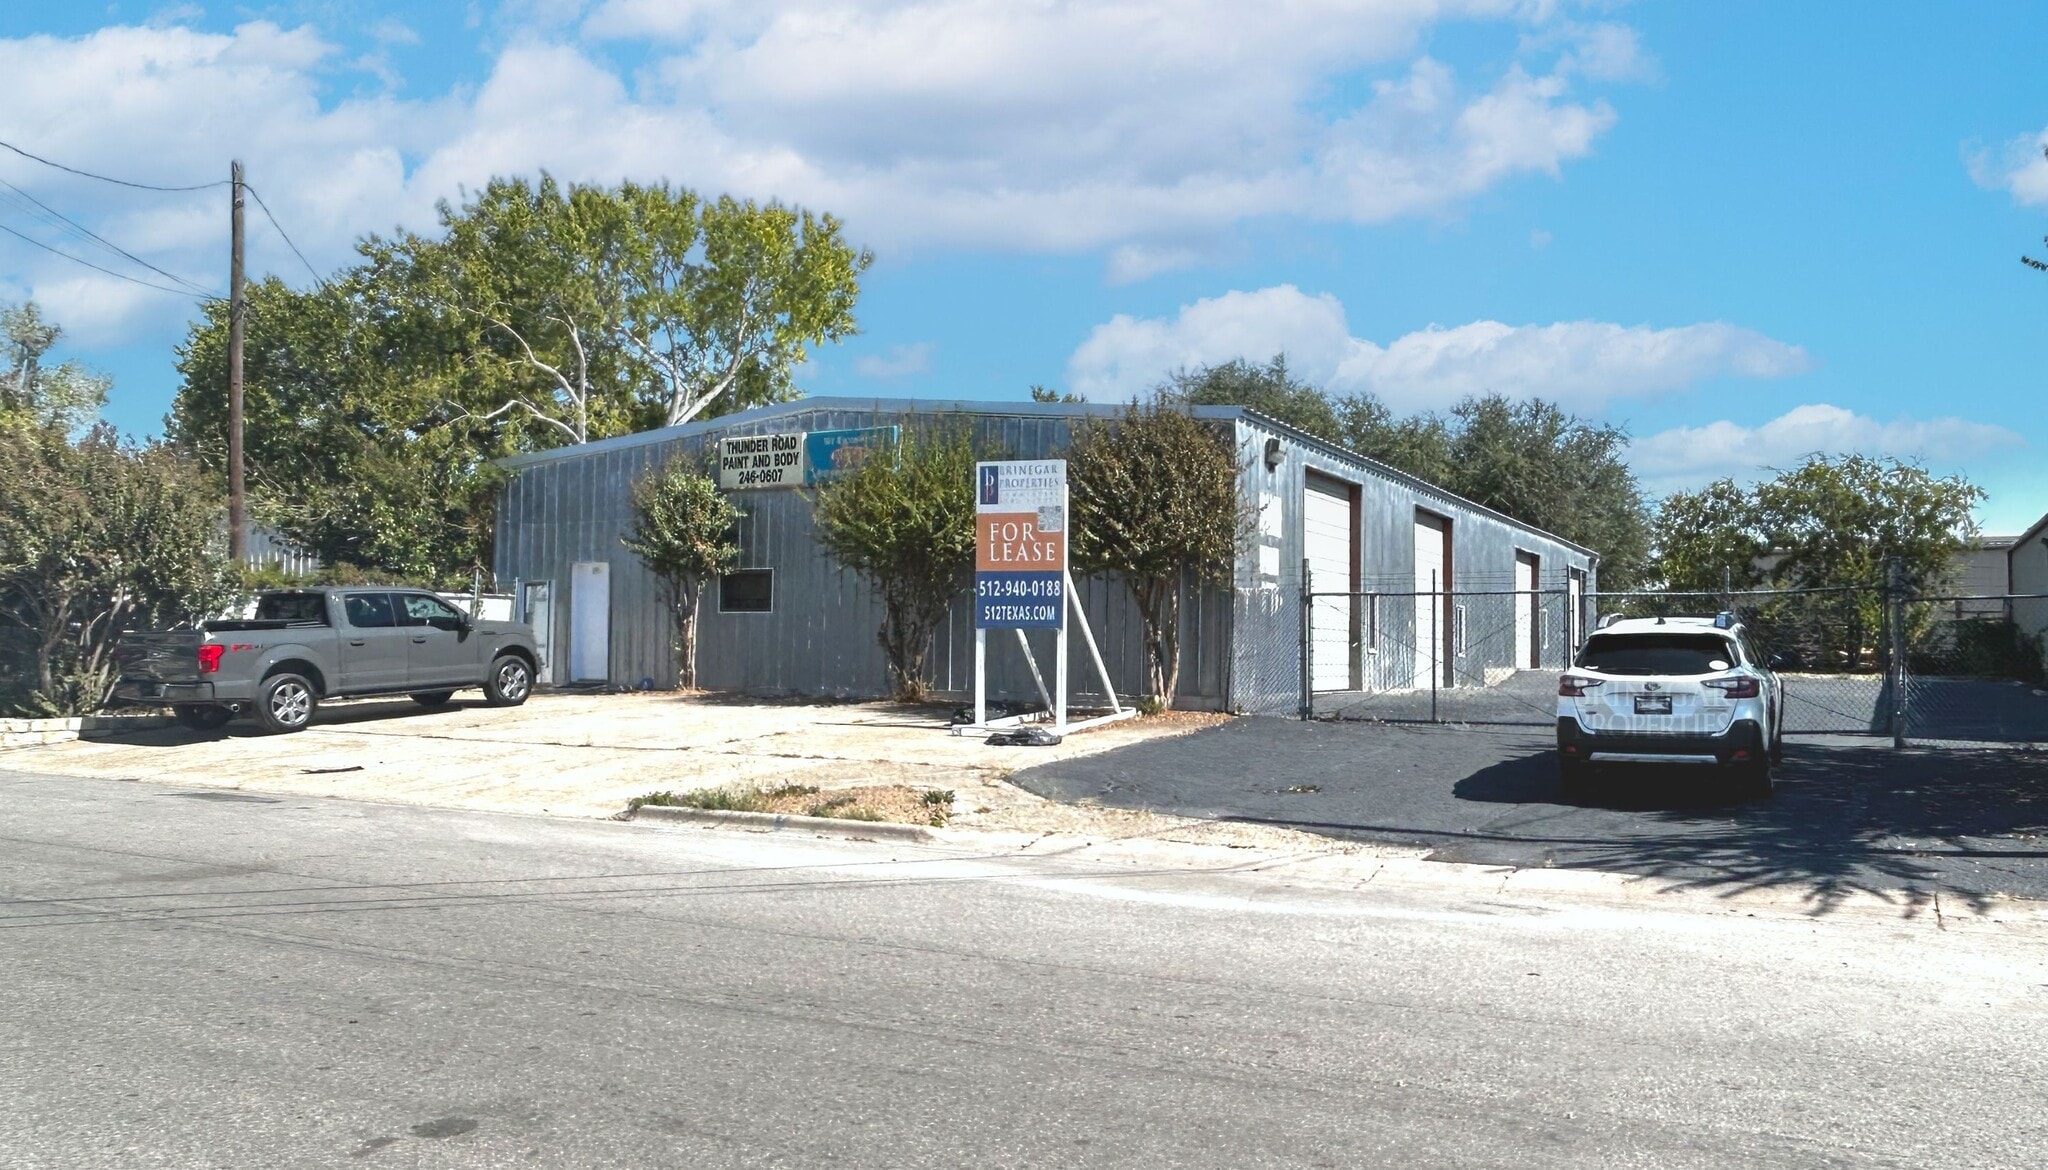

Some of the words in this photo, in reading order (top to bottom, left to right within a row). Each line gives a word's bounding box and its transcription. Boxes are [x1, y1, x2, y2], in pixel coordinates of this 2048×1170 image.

[727, 439, 768, 454] THUNDER
[772, 437, 797, 451] ROAD
[722, 456, 749, 470] PAINT
[752, 454, 771, 468] AND
[774, 452, 800, 467] BODY
[739, 469, 783, 484] 246-0607
[999, 464, 1059, 476] BRINEGAR
[999, 478, 1059, 489] PROPERTIES
[990, 522, 1035, 541] FOR
[990, 542, 1055, 561] LEASE
[979, 580, 1061, 597] 512-940-0188
[984, 605, 1056, 620] 512TEXAS.COM
